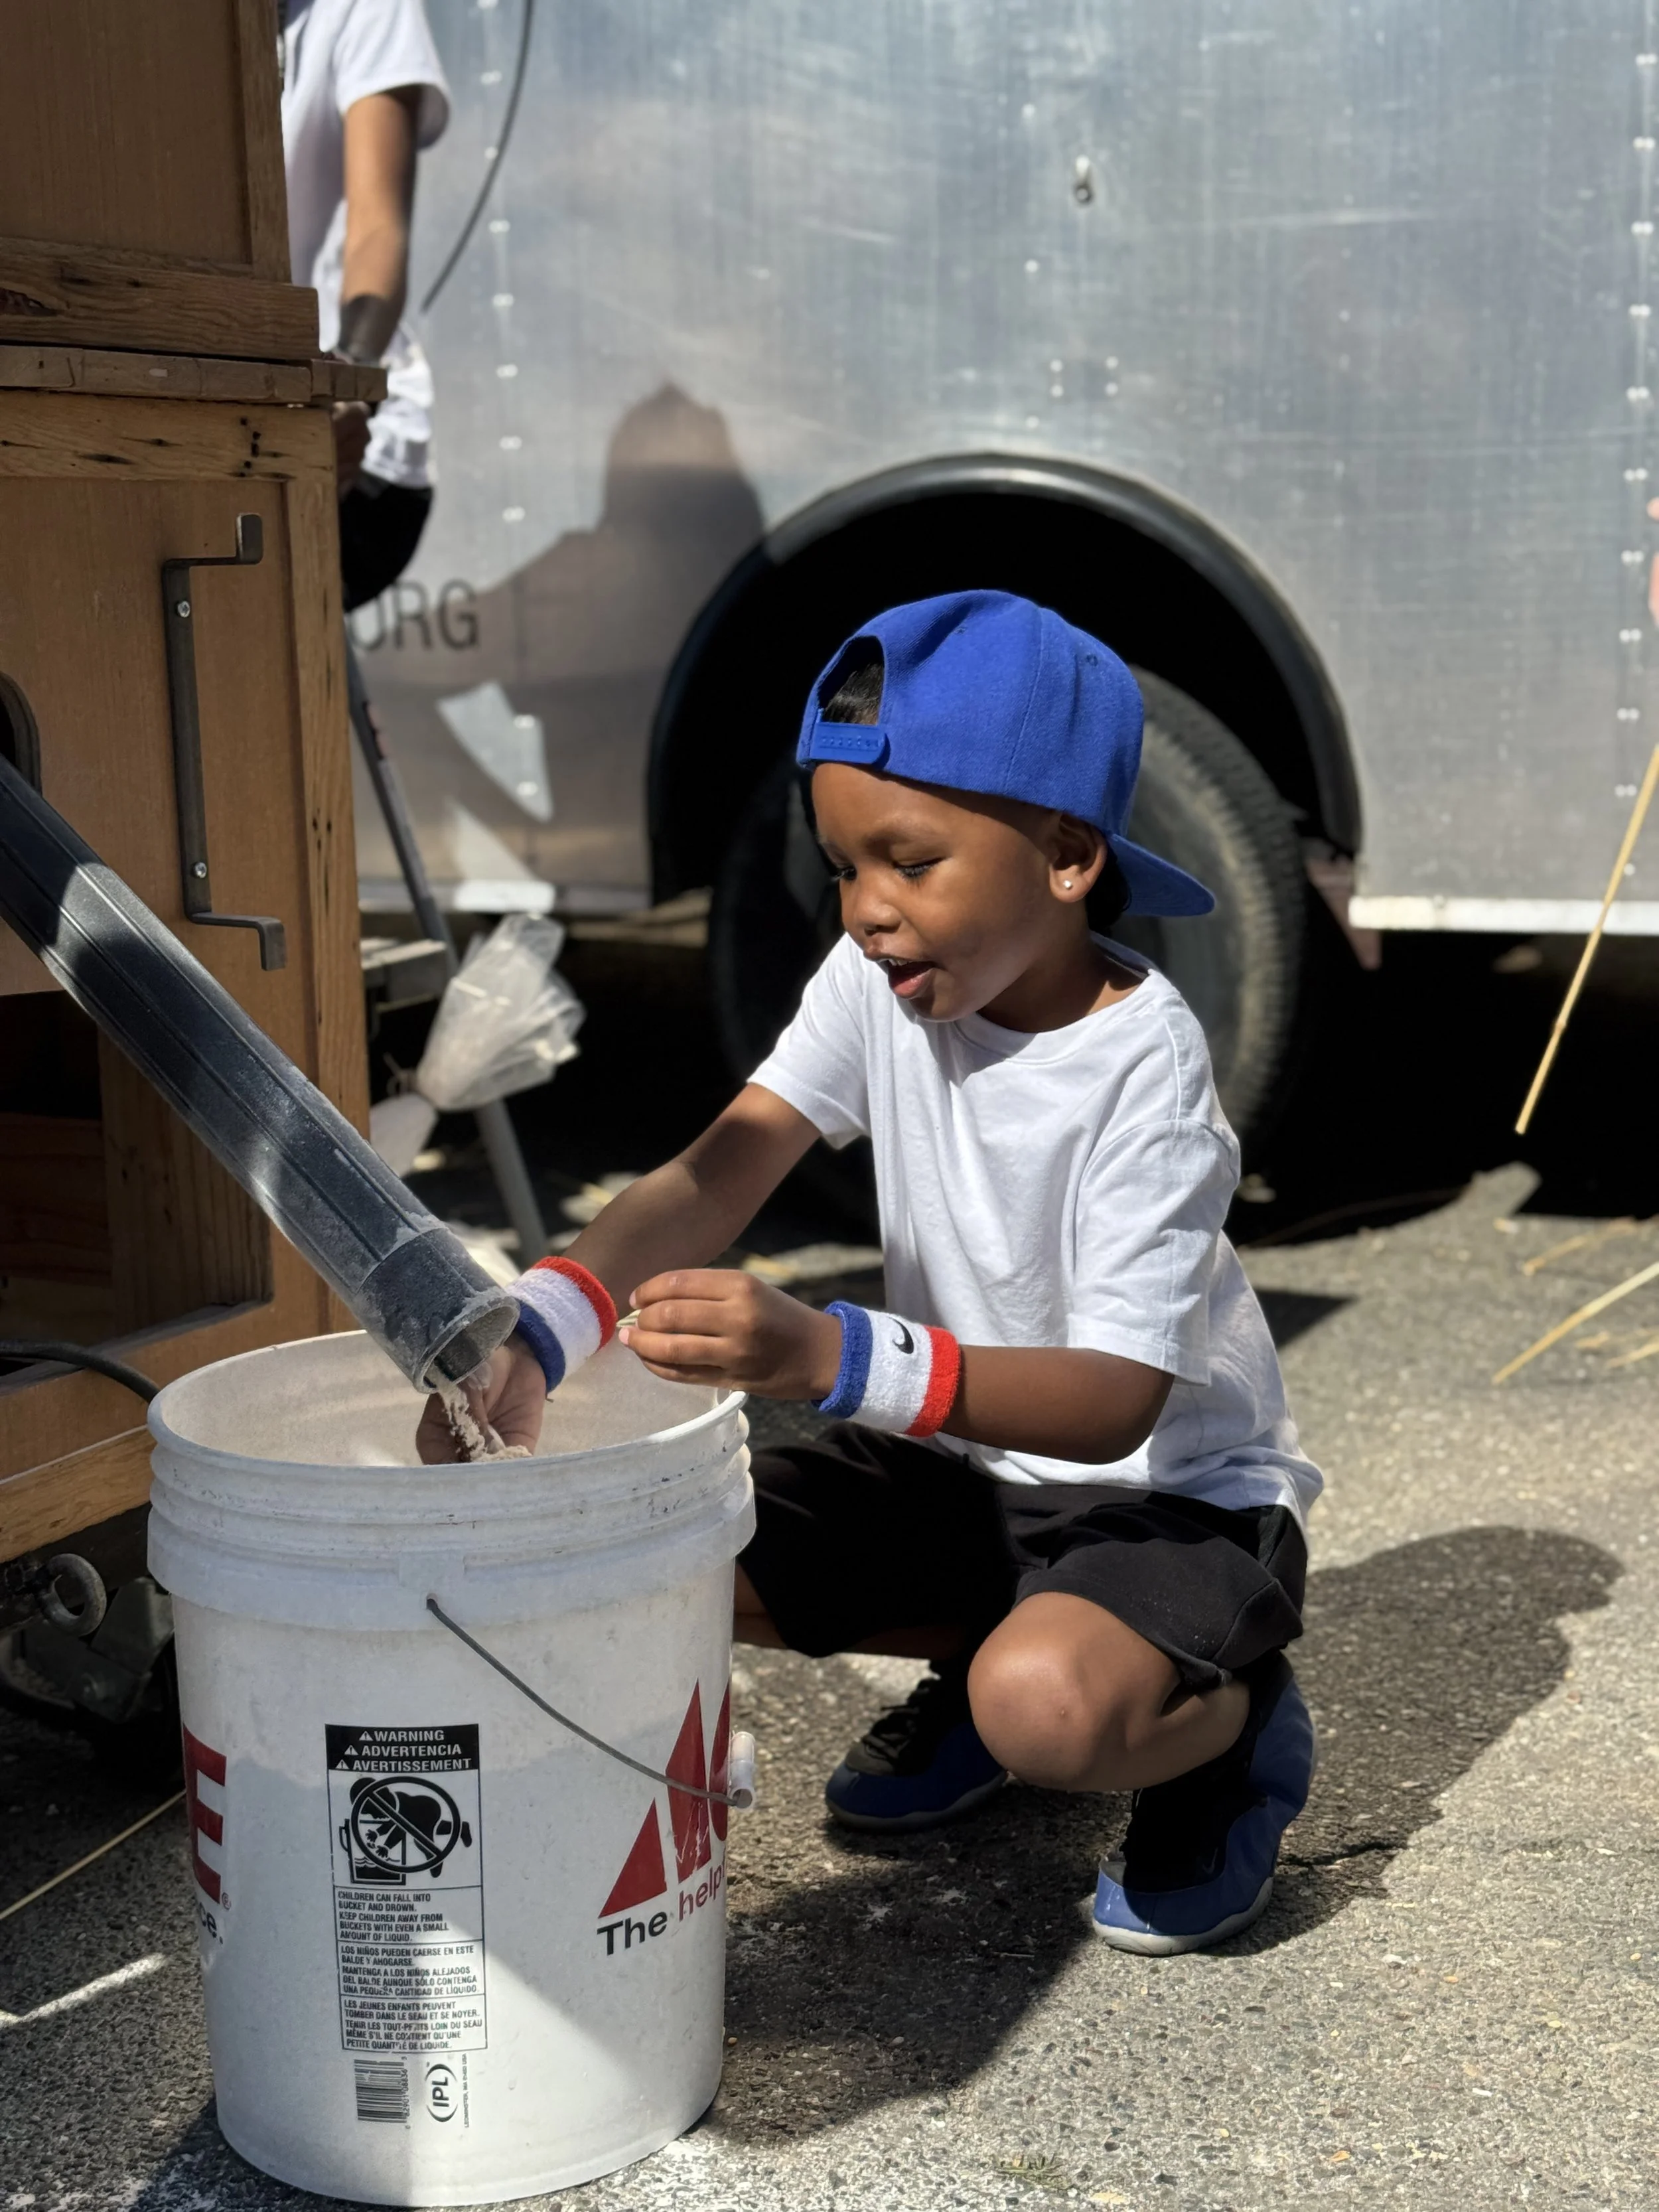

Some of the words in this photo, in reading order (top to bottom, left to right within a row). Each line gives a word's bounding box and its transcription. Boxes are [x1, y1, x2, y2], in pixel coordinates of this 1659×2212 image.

[374, 1730, 444, 1741] WARNING
[362, 1744, 461, 1756] ADVERTENCIA
[352, 1758, 471, 1771] AVERTISSEMENT
[338, 1891, 374, 1901] CHILDREN
[339, 1901, 366, 1910] BUCKET
[340, 1911, 356, 1920] KEEP
[340, 1921, 372, 1931] BUCKETS
[340, 1931, 370, 1941] AMOUNT
[597, 1911, 667, 1956] The
[357, 1946, 379, 1956] NIÑOS
[413, 1948, 440, 1956] CAERSE
[456, 1945, 473, 1954] ESTE
[342, 1955, 364, 1964] BALDE
[342, 1966, 381, 1976] MANTENGA
[407, 1967, 429, 1976] NIÑOS
[432, 1966, 470, 1975] ALEJADOS
[343, 1975, 356, 1984] DEL
[358, 1976, 381, 1986] BALDE
[437, 1976, 477, 1984] CONTENGA
[344, 2000, 356, 2008] LES
[359, 2001, 386, 2010] JEUNES
[345, 2010, 374, 2019] TOMBER
[347, 2039, 370, 2048] PETITE
[432, 2077, 449, 2107] IPL
